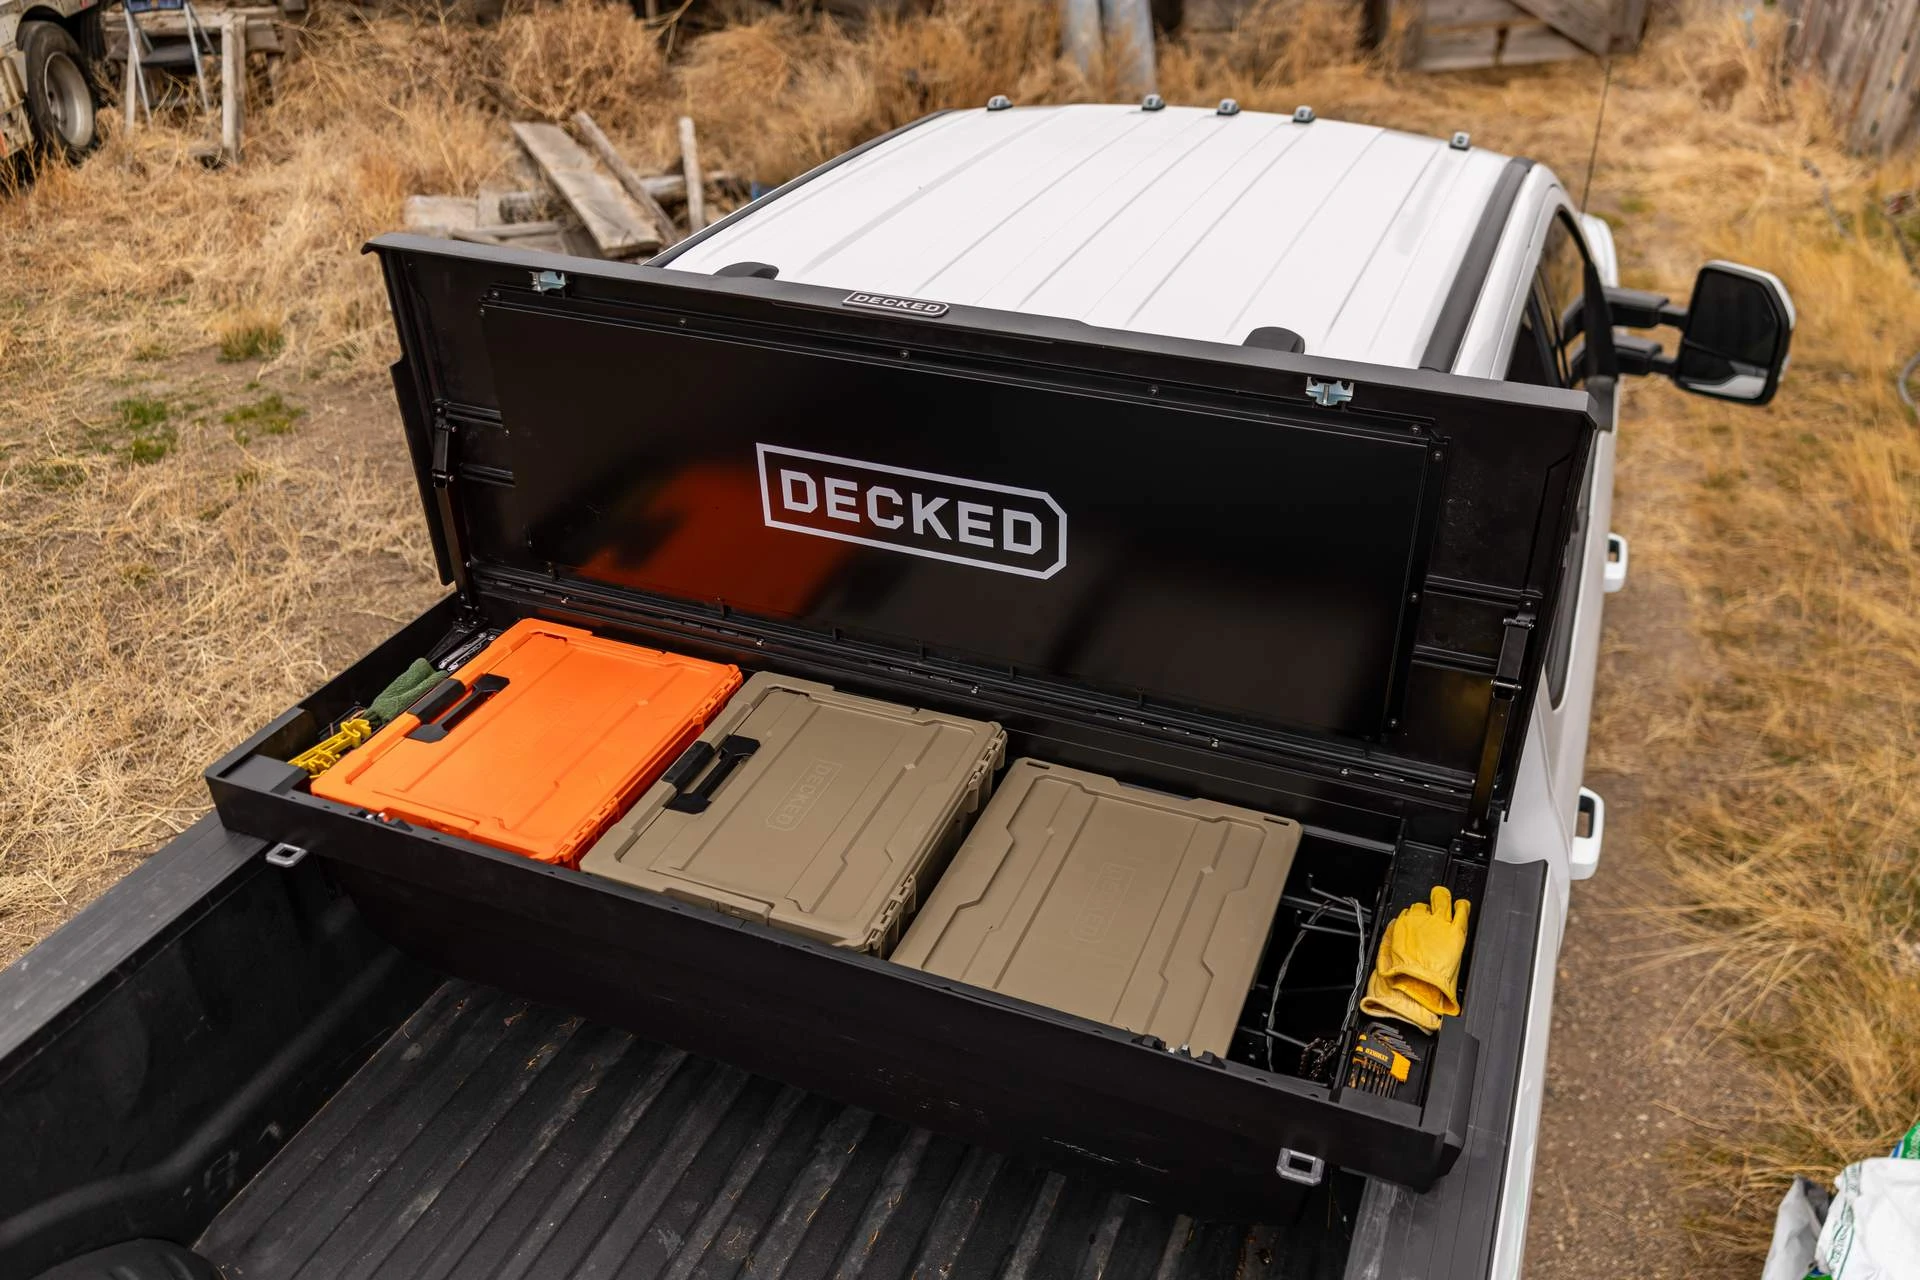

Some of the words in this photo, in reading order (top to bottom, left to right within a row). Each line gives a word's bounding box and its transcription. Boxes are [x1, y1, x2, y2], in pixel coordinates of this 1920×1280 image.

[853, 294, 941, 312] DECKED
[780, 468, 1042, 555] DECKED
[777, 763, 834, 825] DECKED
